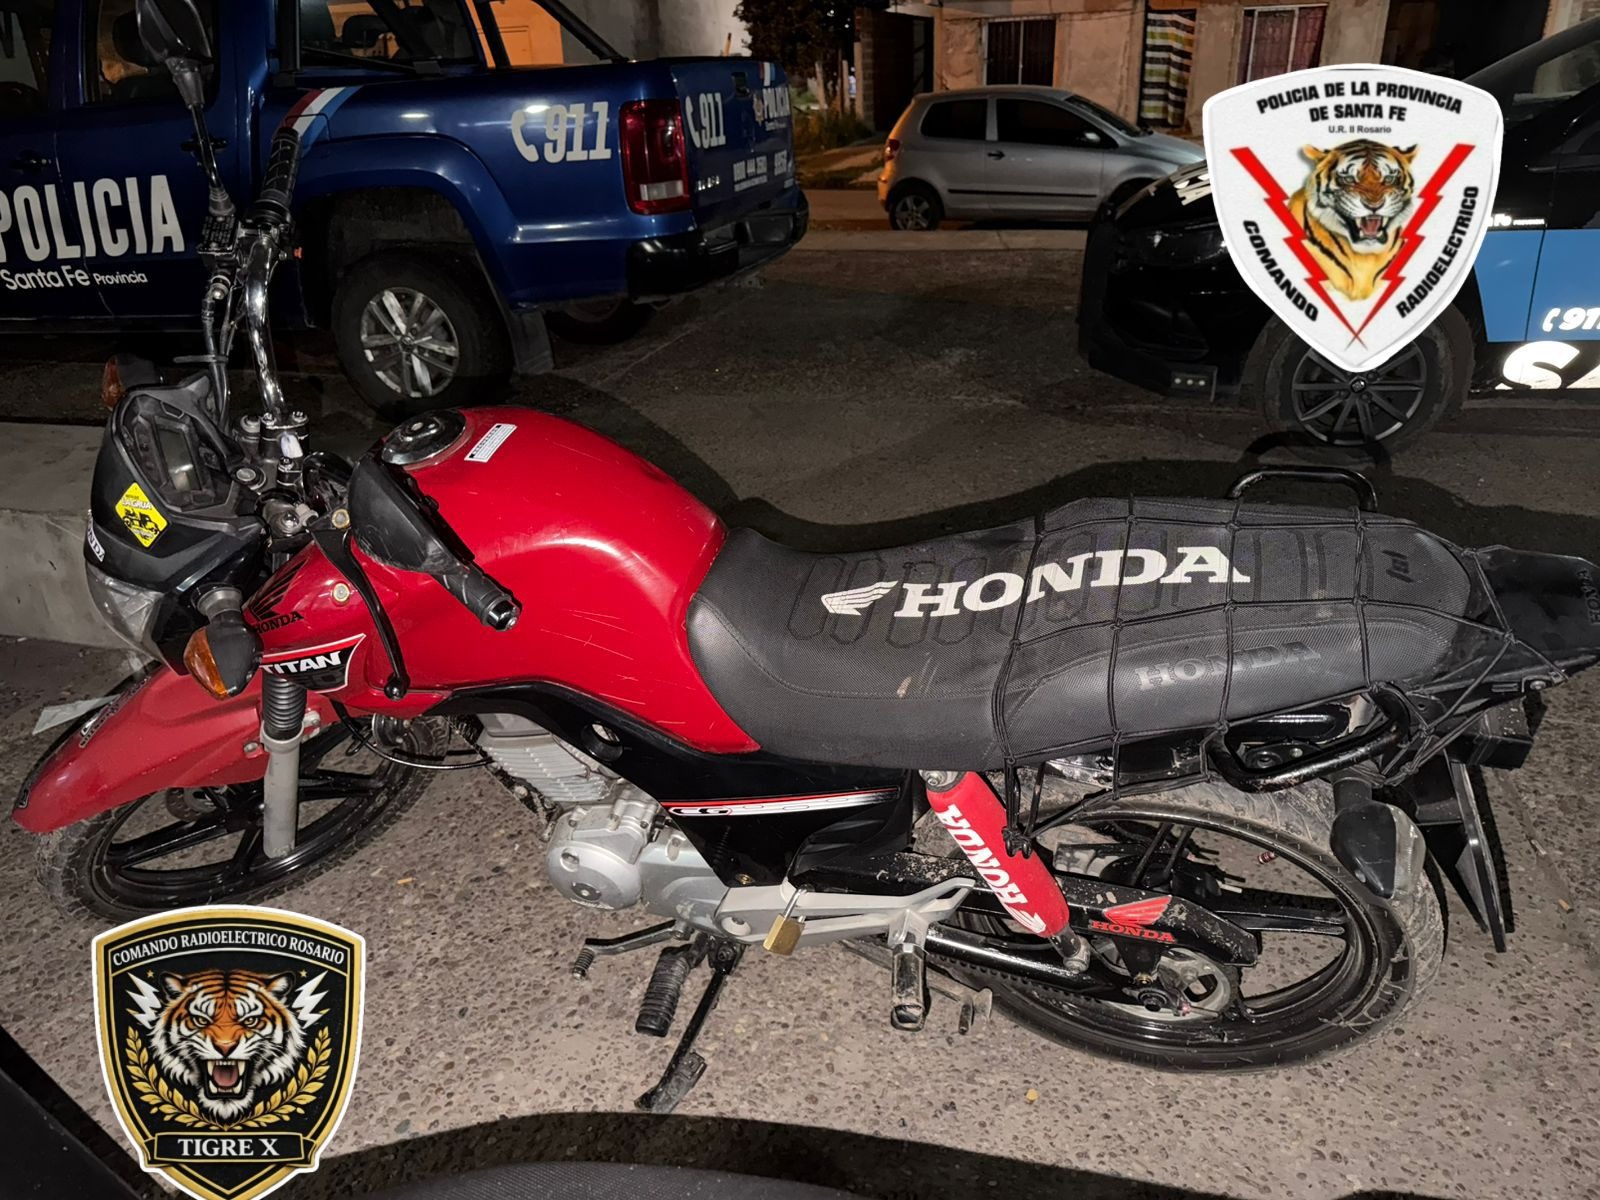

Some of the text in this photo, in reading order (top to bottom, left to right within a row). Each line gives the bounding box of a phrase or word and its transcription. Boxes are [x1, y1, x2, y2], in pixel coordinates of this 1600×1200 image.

[543, 101, 612, 163] 911
[700, 92, 727, 149] 911
[0, 265, 149, 290] Santa Fe Provincia
[1559, 307, 1600, 331] 91
[894, 546, 1251, 617] HONDA
[255, 611, 305, 633] HONDA
[259, 650, 342, 675] TITAN
[1134, 640, 1322, 690] HONDA
[935, 803, 1029, 906] HONDA
[1091, 919, 1177, 943] HONDA
